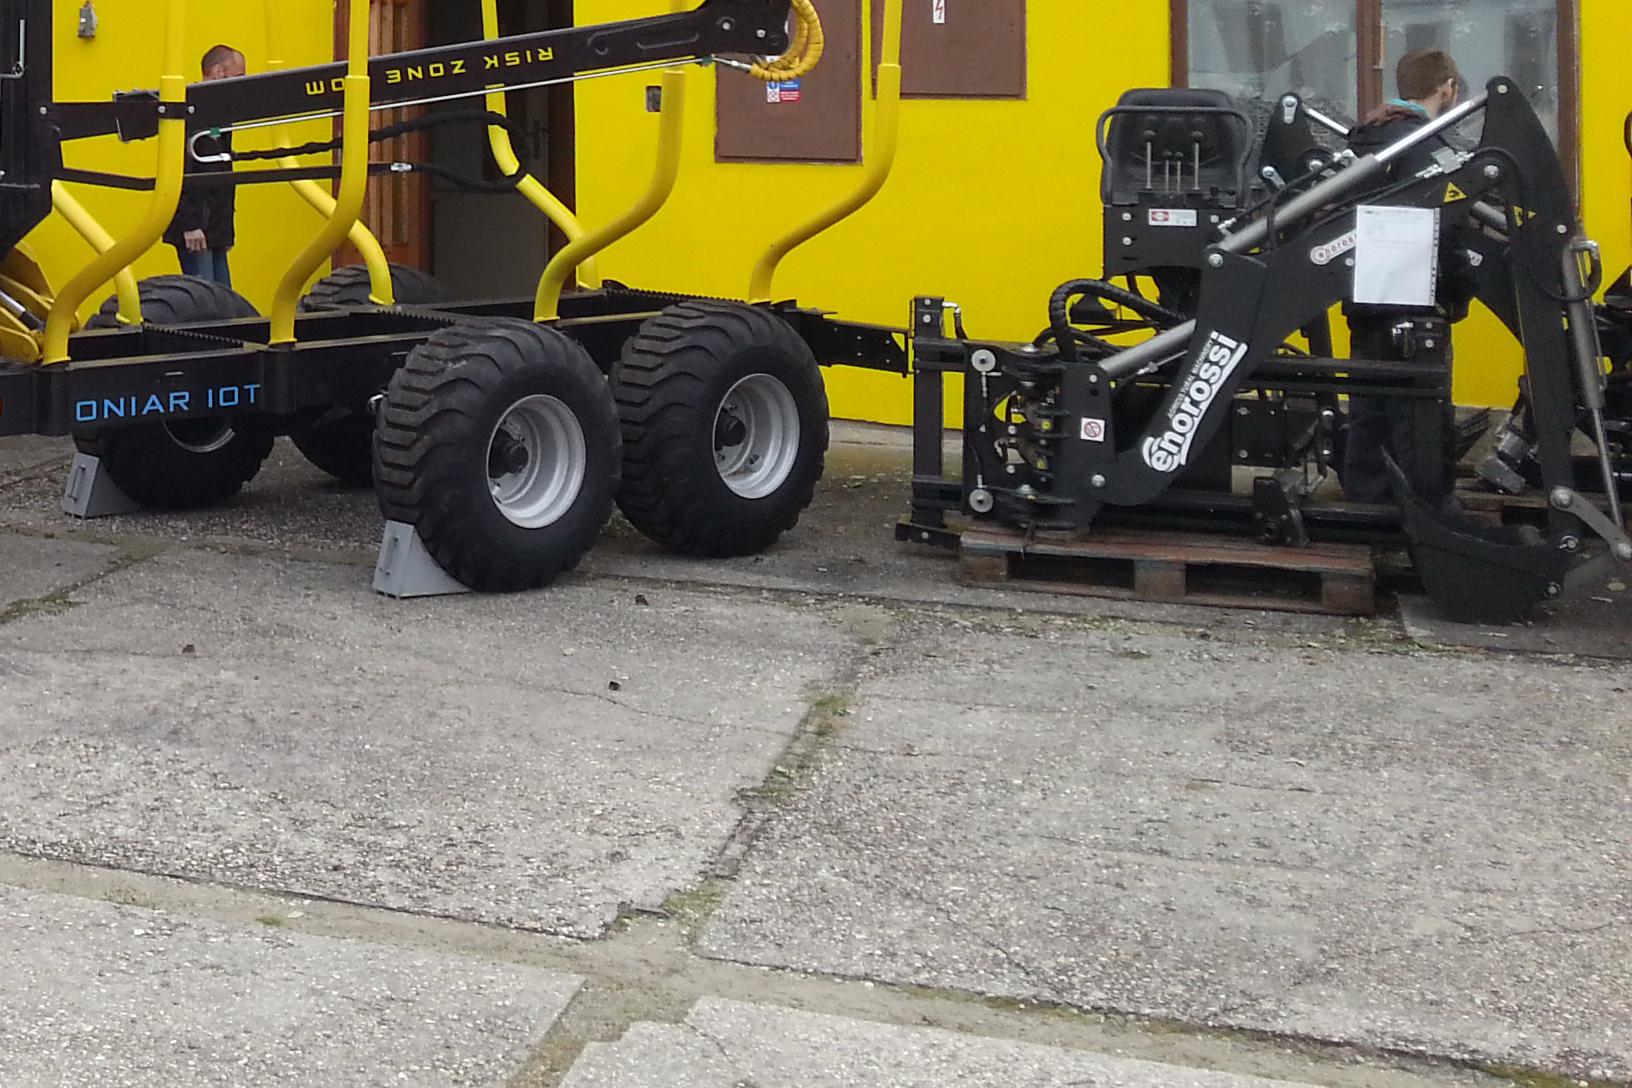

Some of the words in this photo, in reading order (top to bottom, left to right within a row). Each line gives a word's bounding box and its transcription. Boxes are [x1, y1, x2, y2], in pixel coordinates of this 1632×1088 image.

[384, 59, 467, 85] ZONE
[482, 46, 555, 70] RISK
[75, 391, 190, 422] ONIAR
[1146, 330, 1242, 472] enorossi
